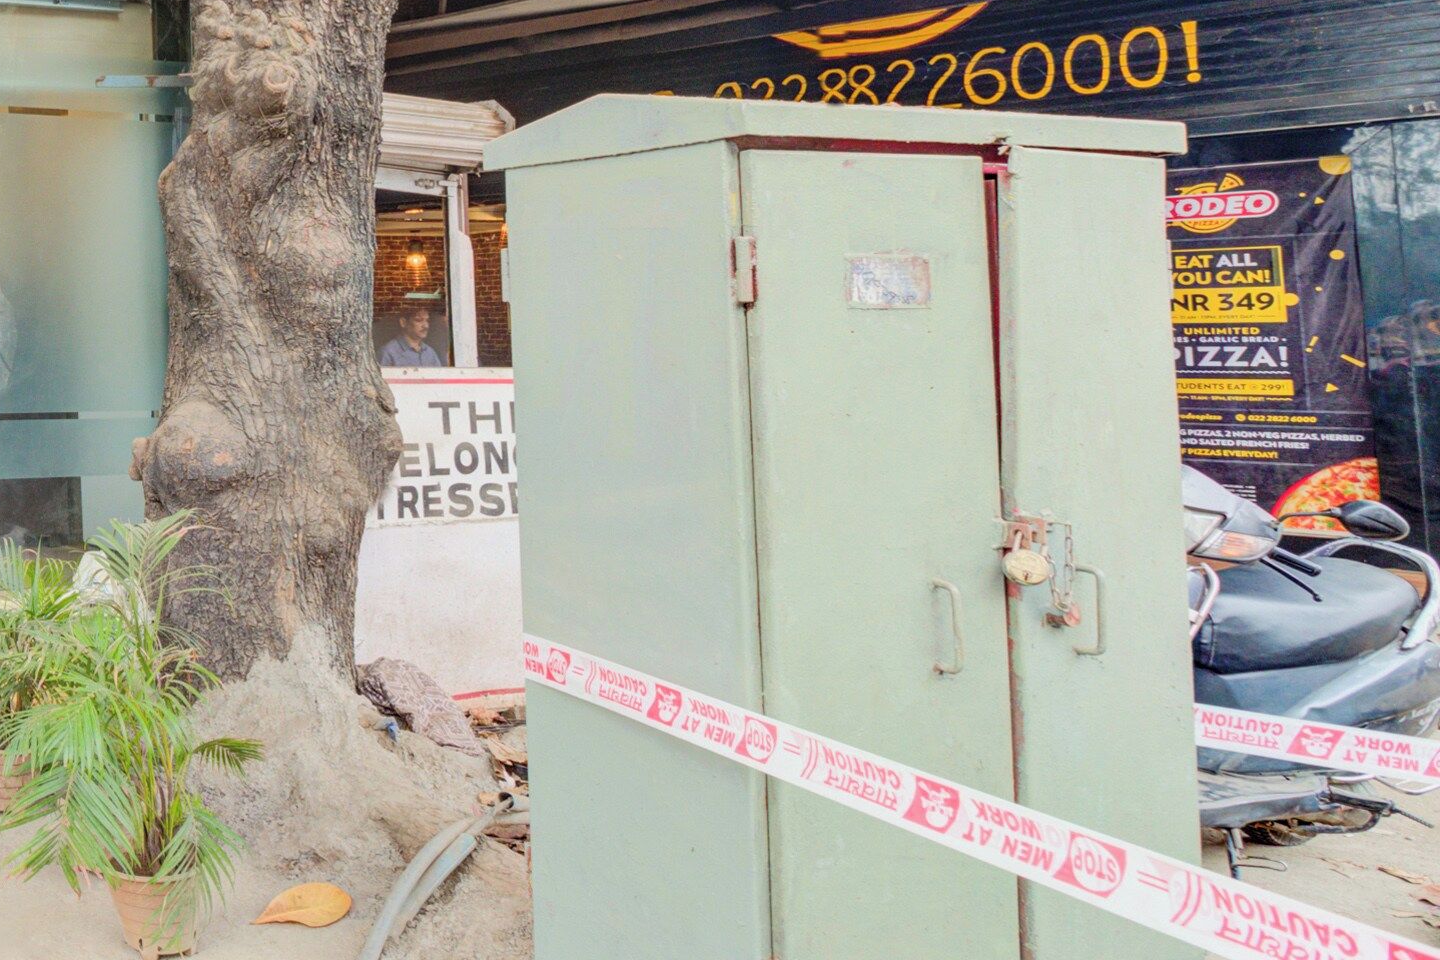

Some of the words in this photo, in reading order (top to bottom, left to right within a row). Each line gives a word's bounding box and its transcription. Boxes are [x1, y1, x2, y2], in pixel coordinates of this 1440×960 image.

[1175, 255, 1213, 269] EAT
[1216, 253, 1258, 267] ALL
[1216, 270, 1271, 284] CAN!
[1218, 292, 1274, 311] 349
[1184, 327, 1260, 335] UNLIMITED
[1199, 438, 1235, 446] SALTED
[1236, 440, 1277, 448] FRENCH
[1321, 433, 1365, 442] HERBED
[1188, 449, 1222, 457] PIZZAS
[523, 642, 539, 658] WO
[525, 658, 545, 676] MEN
[599, 667, 647, 696] CAUTION
[599, 685, 643, 712] सावधान
[689, 697, 730, 724] WORK
[681, 716, 701, 733] AT
[704, 723, 736, 748] MEN
[1201, 712, 1284, 736] CAUTION
[748, 725, 774, 753] STOP
[1202, 726, 1280, 750] सावधान
[1354, 735, 1412, 754] WORK
[824, 746, 901, 788] CAUTION
[1343, 749, 1367, 763] AT
[1377, 755, 1419, 772] MEN
[824, 772, 899, 811] सावधान
[970, 798, 1042, 841] WORK
[962, 822, 993, 846] AT
[1001, 835, 1055, 872] MEN
[1073, 847, 1117, 883] STOP
[1211, 882, 1358, 956] CAUTION
